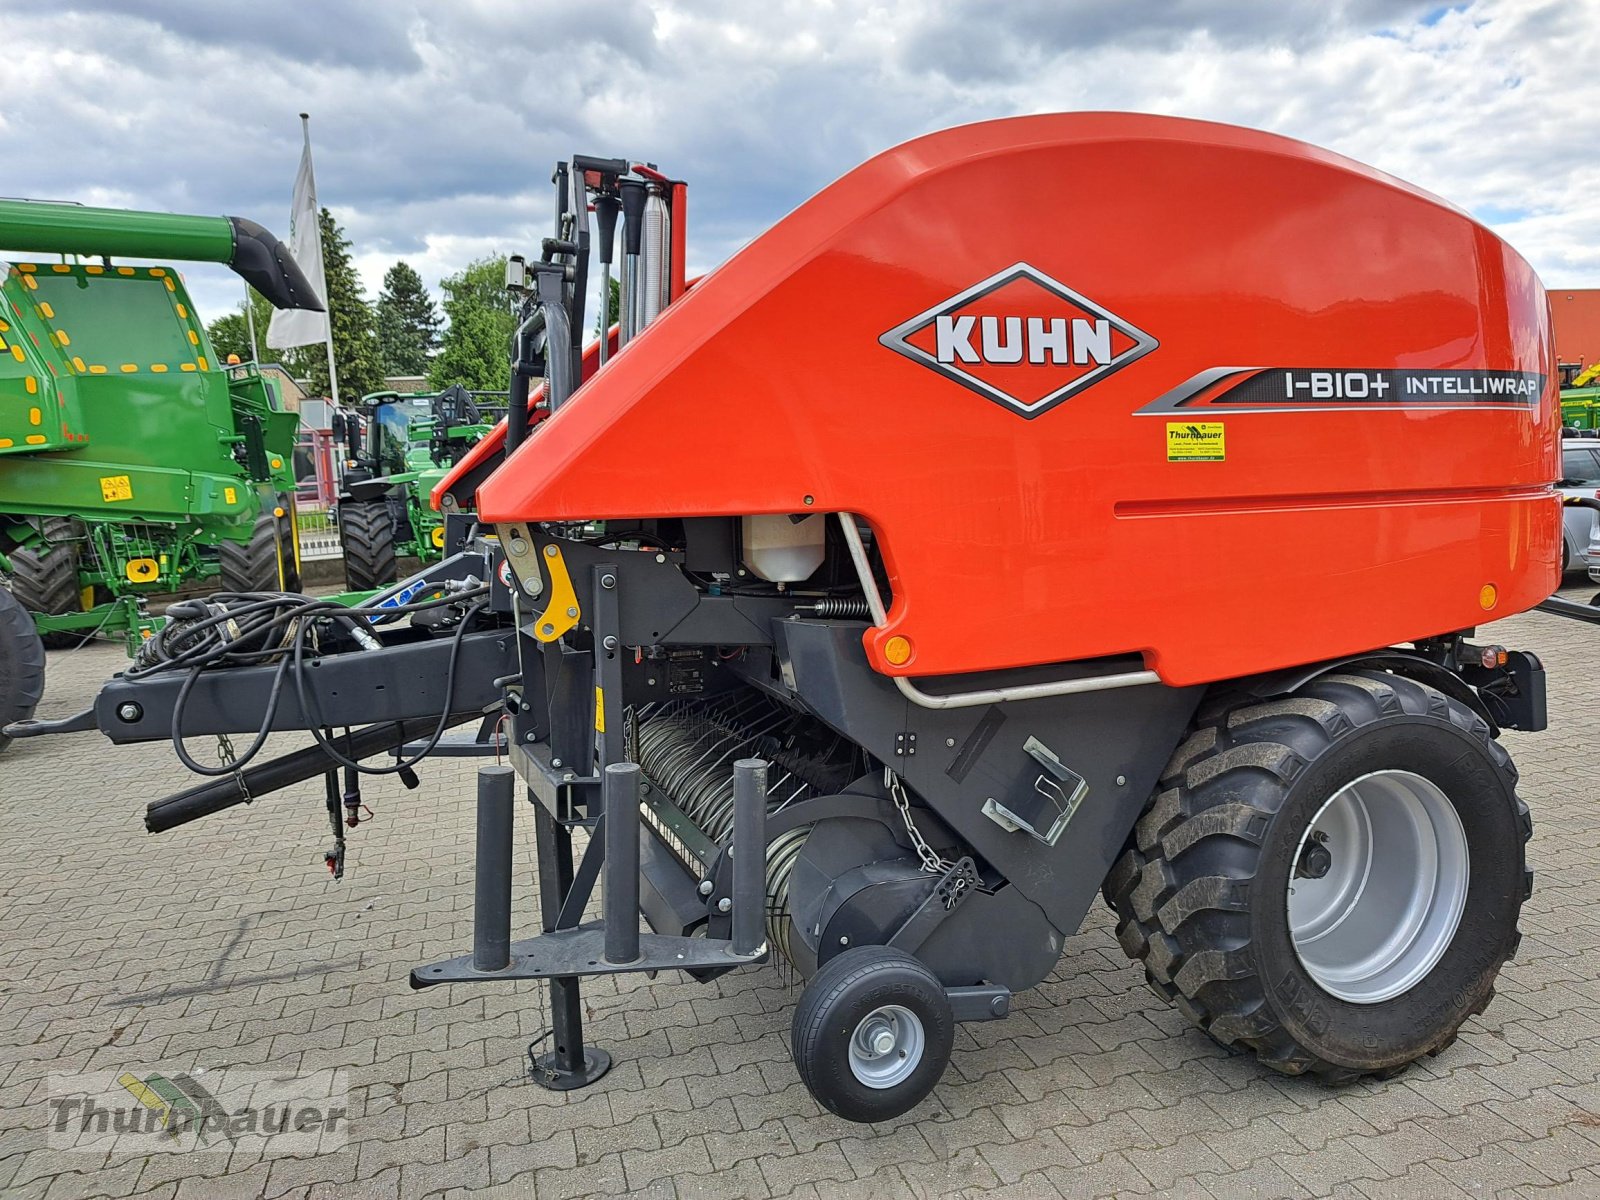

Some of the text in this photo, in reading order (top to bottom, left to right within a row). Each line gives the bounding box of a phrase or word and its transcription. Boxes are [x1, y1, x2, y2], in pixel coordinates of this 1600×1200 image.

[936, 315, 1111, 365] KUHN
[1406, 376, 1537, 396] INTELLIWRAP
[1169, 430, 1221, 439] Thurnbauer
